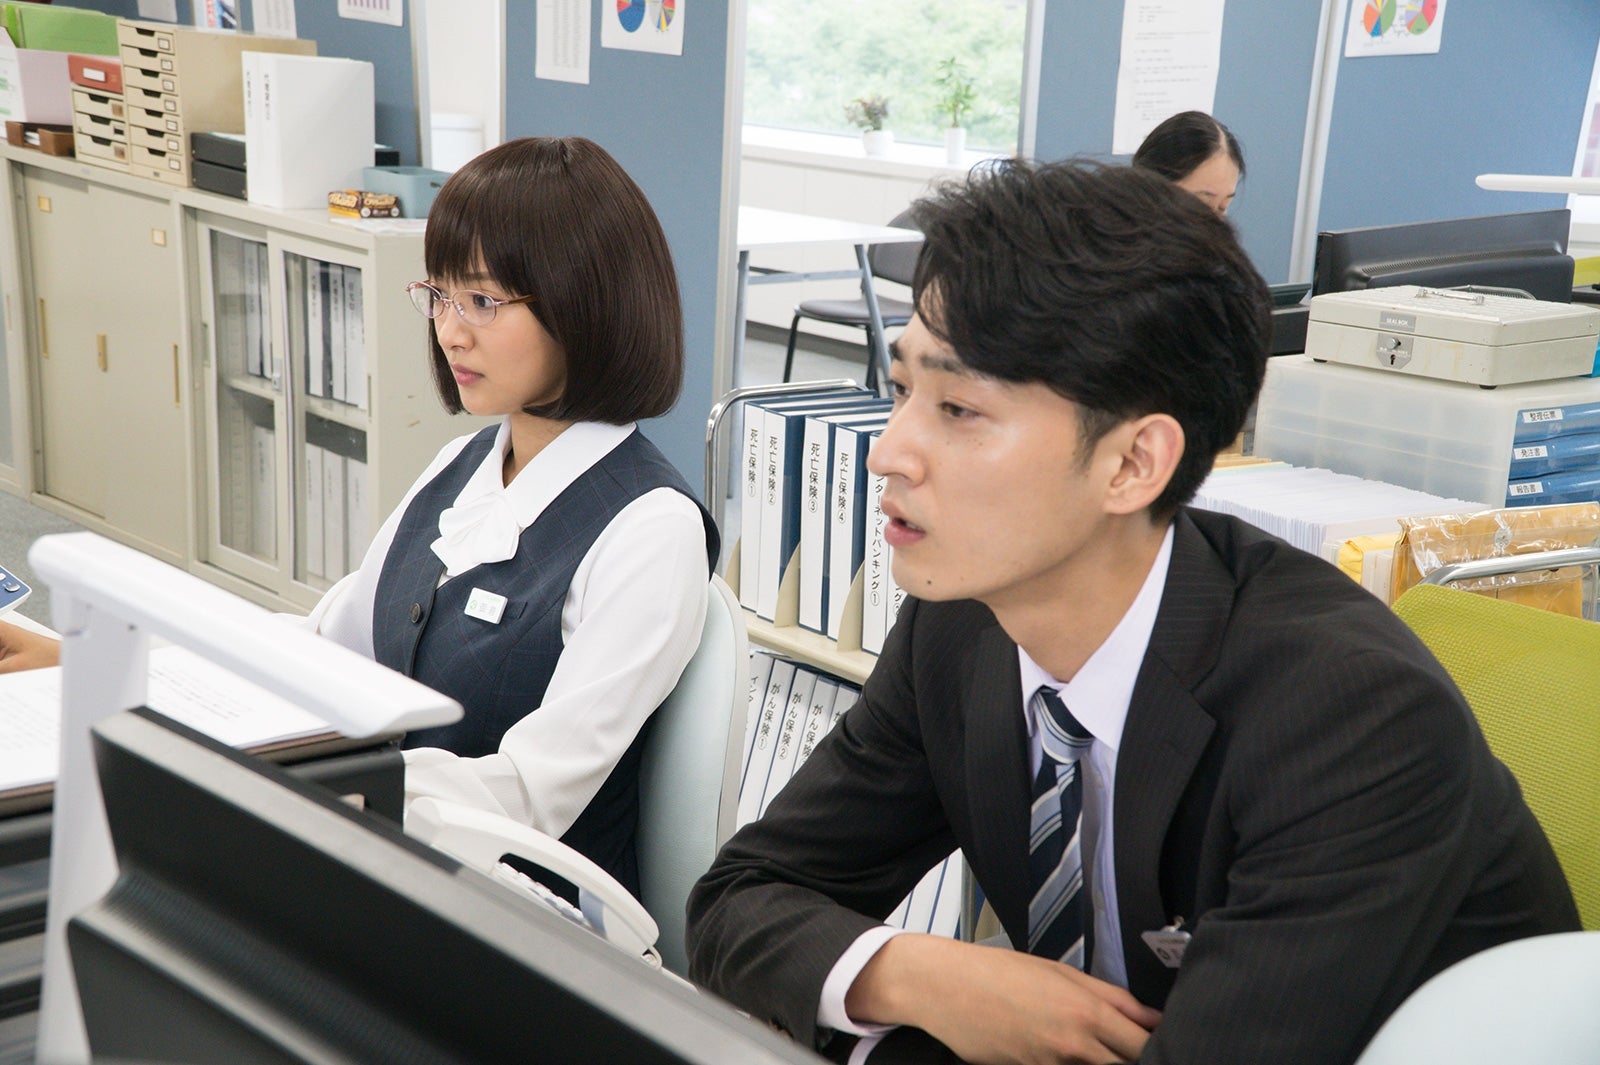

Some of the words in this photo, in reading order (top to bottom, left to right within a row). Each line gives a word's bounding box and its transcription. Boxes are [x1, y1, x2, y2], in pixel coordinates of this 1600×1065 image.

[747, 428, 759, 498] 死亡保険①
[767, 435, 779, 506] 死亡保険②
[807, 442, 821, 514] 死亡保険③
[837, 452, 850, 525] 死亡保険④
[758, 683, 781, 751] がん保険①
[778, 692, 803, 761] がん保険②
